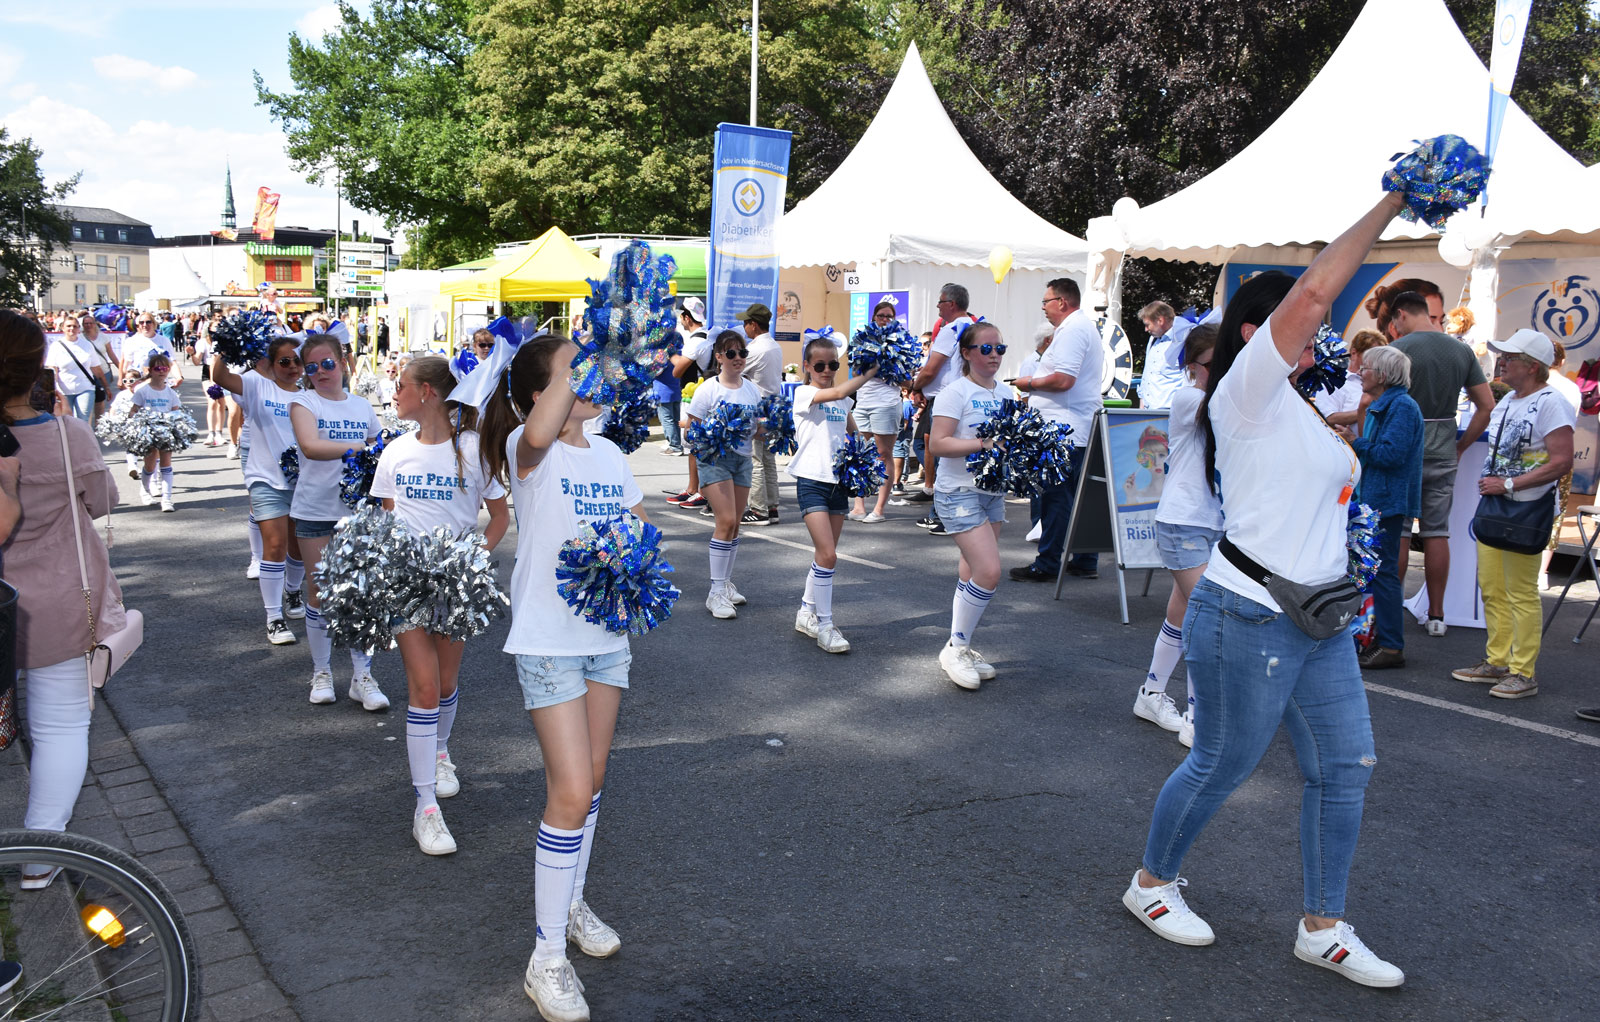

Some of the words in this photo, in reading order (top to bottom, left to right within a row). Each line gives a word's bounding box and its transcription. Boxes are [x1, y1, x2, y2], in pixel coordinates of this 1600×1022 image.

[741, 158, 785, 172] Niedersachsen
[721, 222, 773, 237] Diabetiker
[848, 276, 860, 285] 63
[264, 399, 286, 410] BLUE
[971, 399, 994, 409] BLUE
[318, 419, 341, 429] BLUE
[342, 419, 369, 430] PEAR
[328, 430, 364, 440] CHEERS
[395, 473, 423, 486] BLUE
[426, 472, 468, 488] PEARL
[405, 486, 453, 501] CHEERS
[590, 482, 624, 499] PEAR
[574, 498, 621, 516] CHEERS
